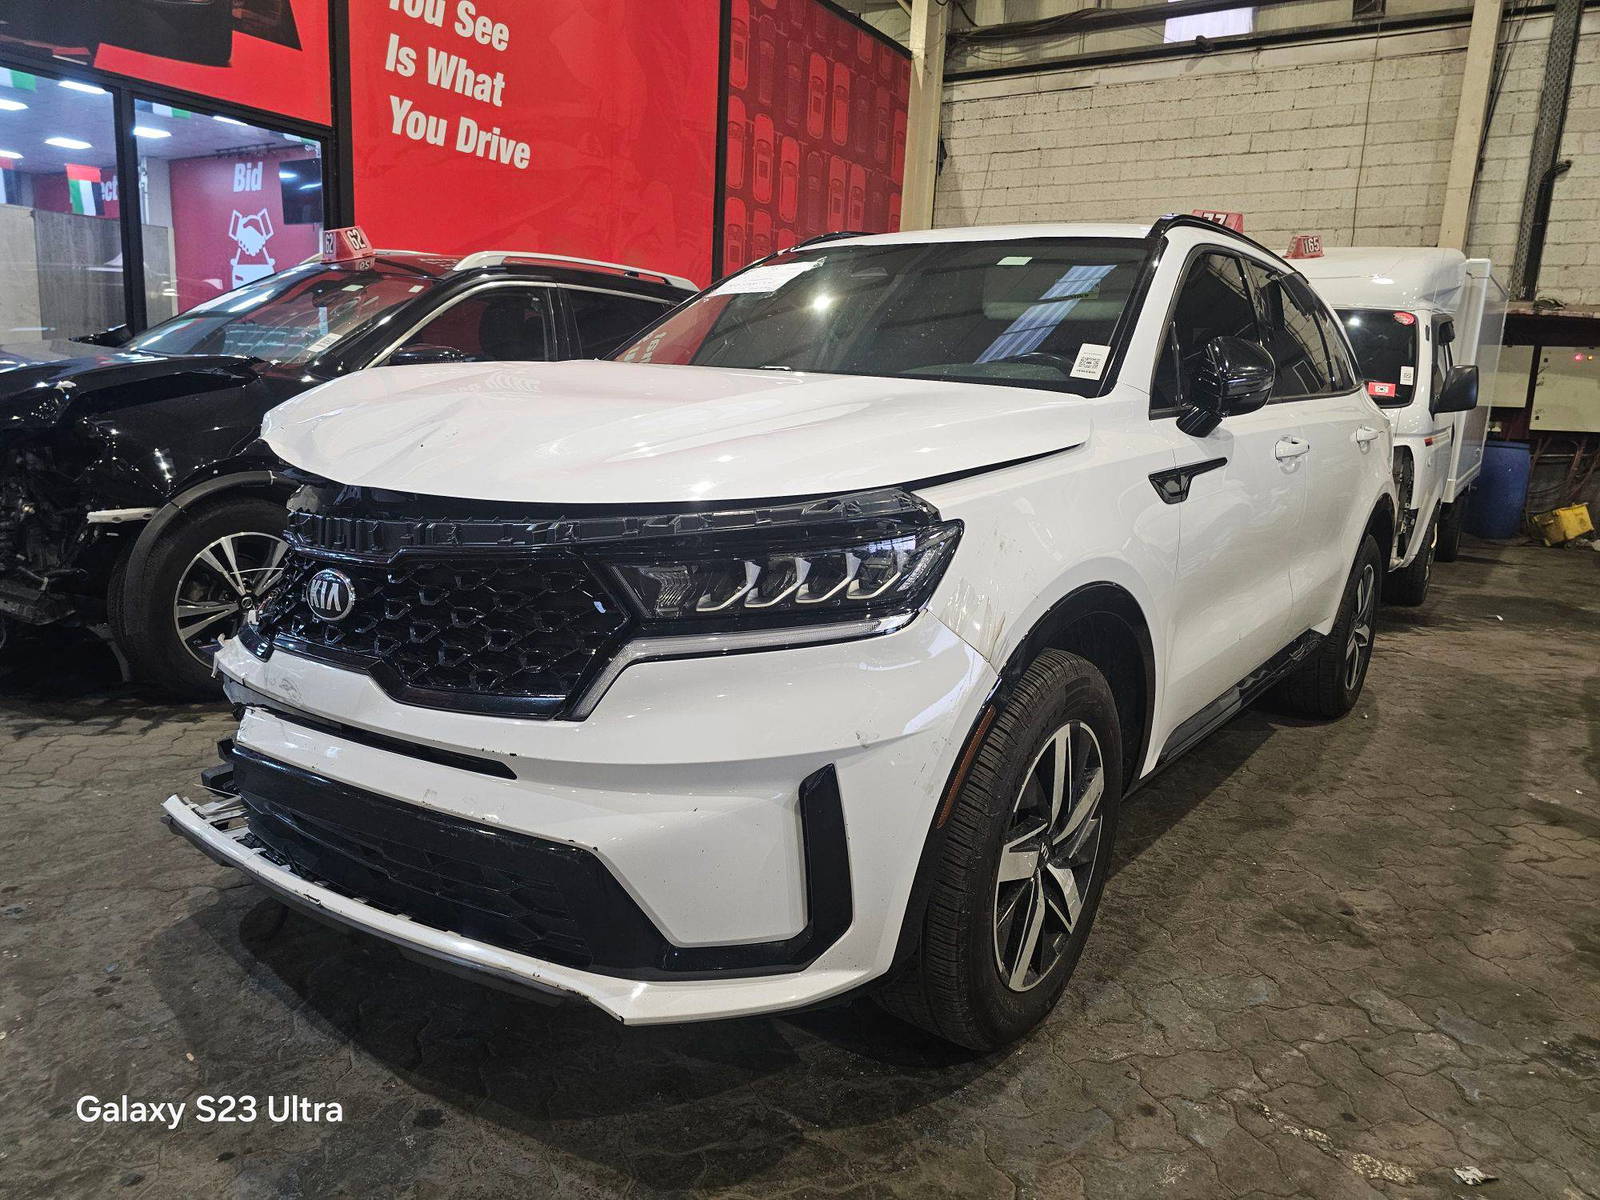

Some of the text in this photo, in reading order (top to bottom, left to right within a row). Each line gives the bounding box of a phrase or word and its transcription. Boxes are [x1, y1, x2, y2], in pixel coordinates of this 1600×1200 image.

[389, 0, 510, 52] ou See
[385, 33, 506, 107] Is What
[389, 94, 531, 170] You Drive
[233, 161, 264, 192] Bid
[325, 232, 334, 254] 62
[346, 228, 367, 251] 62
[1304, 236, 1320, 254] 165
[310, 579, 342, 611] KIA
